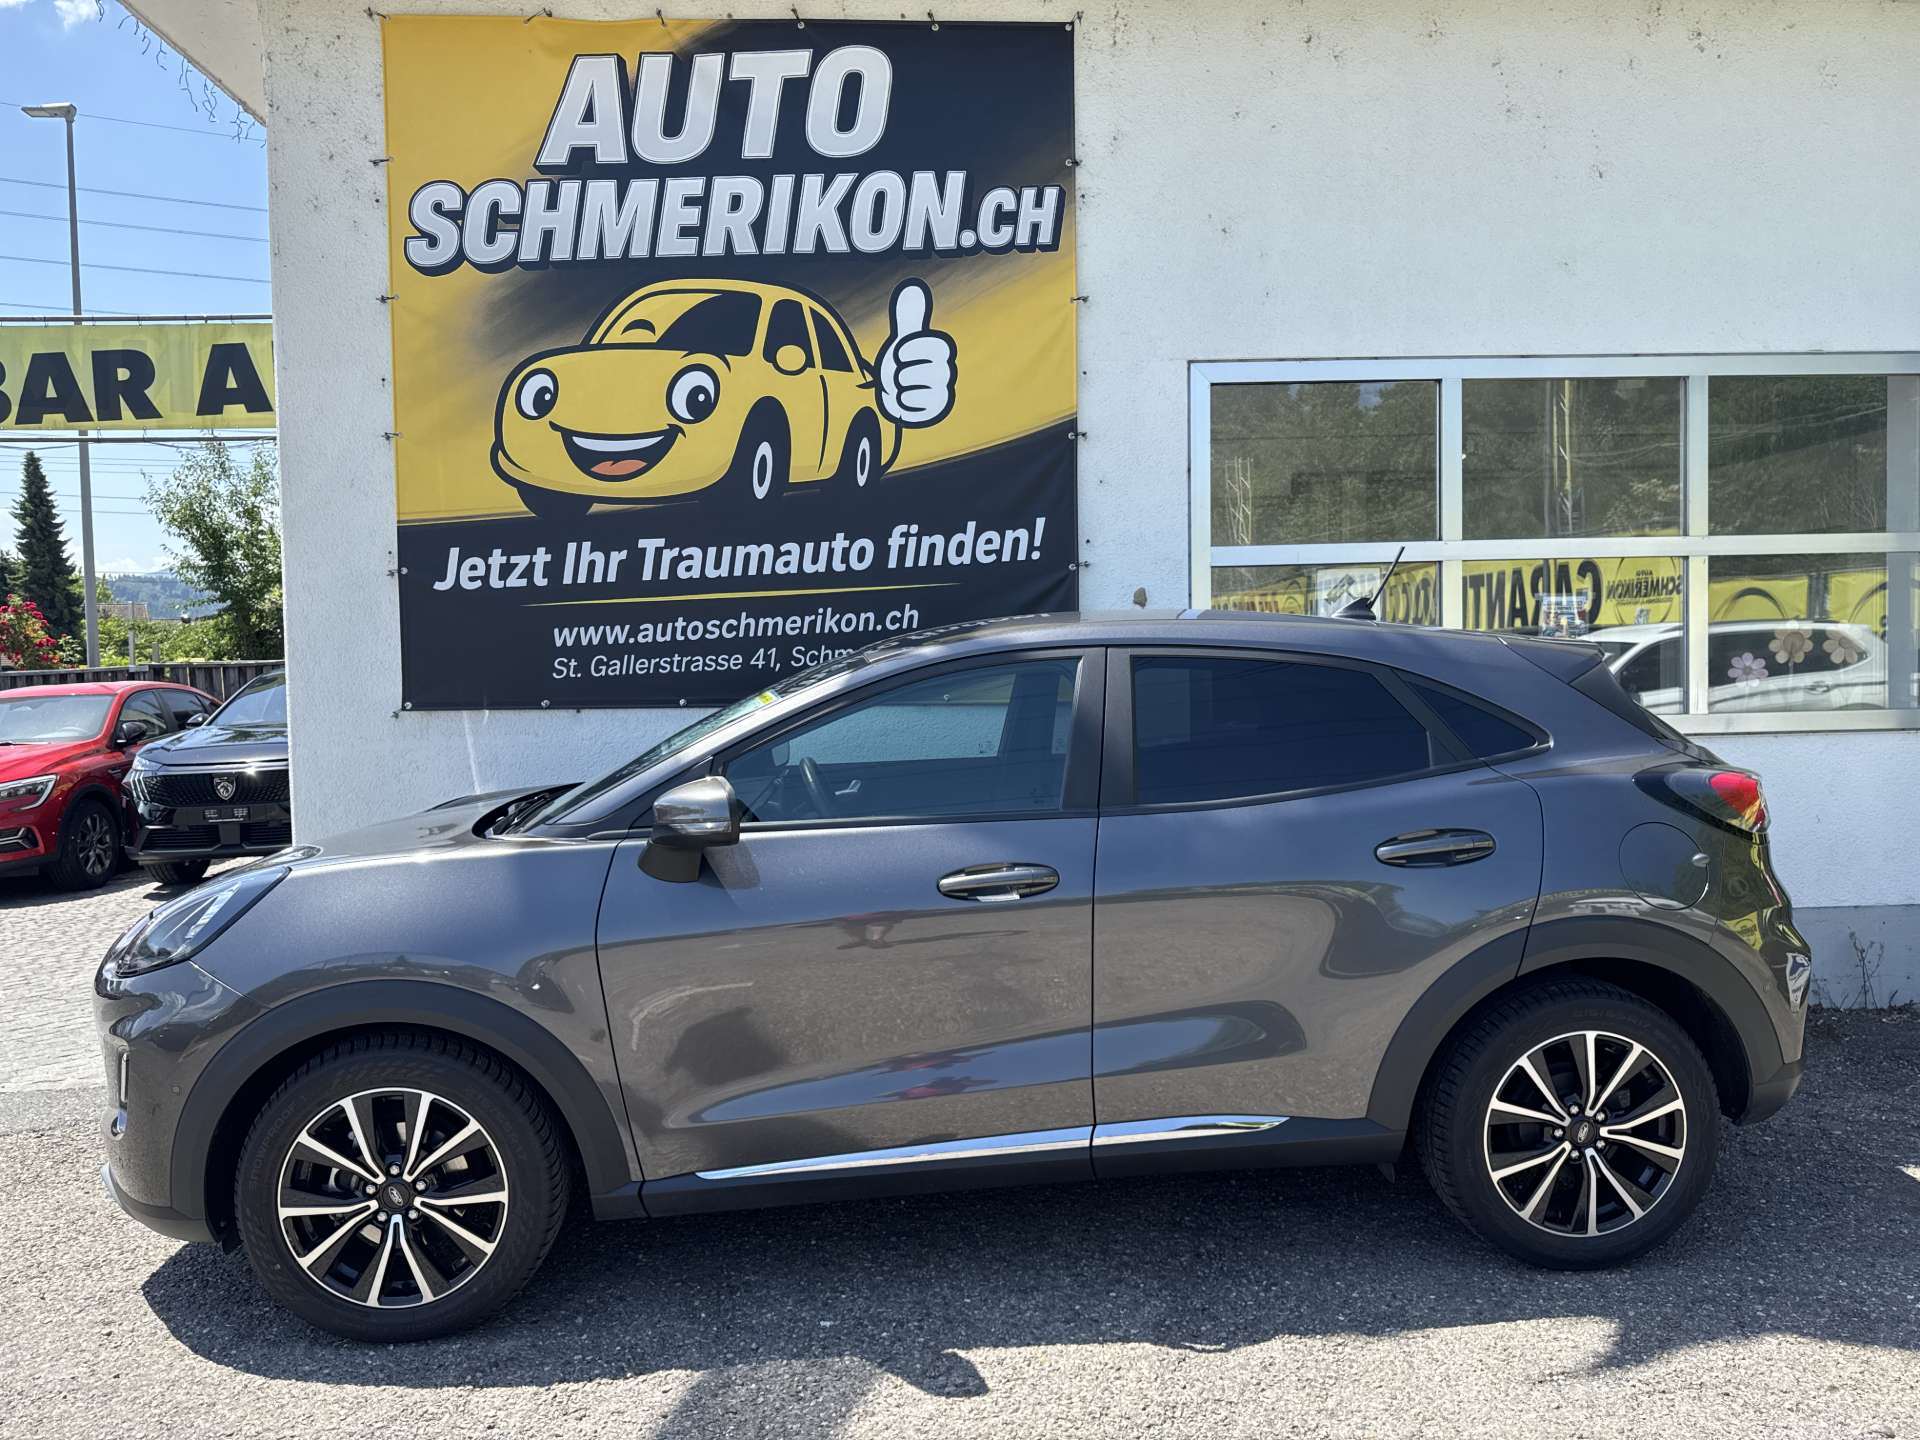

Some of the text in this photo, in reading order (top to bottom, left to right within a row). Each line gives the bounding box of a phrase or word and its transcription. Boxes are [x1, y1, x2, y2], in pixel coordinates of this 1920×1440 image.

[535, 44, 893, 167] AUTO
[405, 170, 1060, 267] SCHMERIKON.CH
[0, 342, 275, 424] AR A
[432, 517, 1046, 591] Jetzt Ihr Traumauto finden!
[552, 603, 919, 648] www.autoschmerikon.ch
[552, 657, 582, 679] St.
[590, 653, 743, 678] Gallerstrasse
[749, 647, 782, 673] 41,
